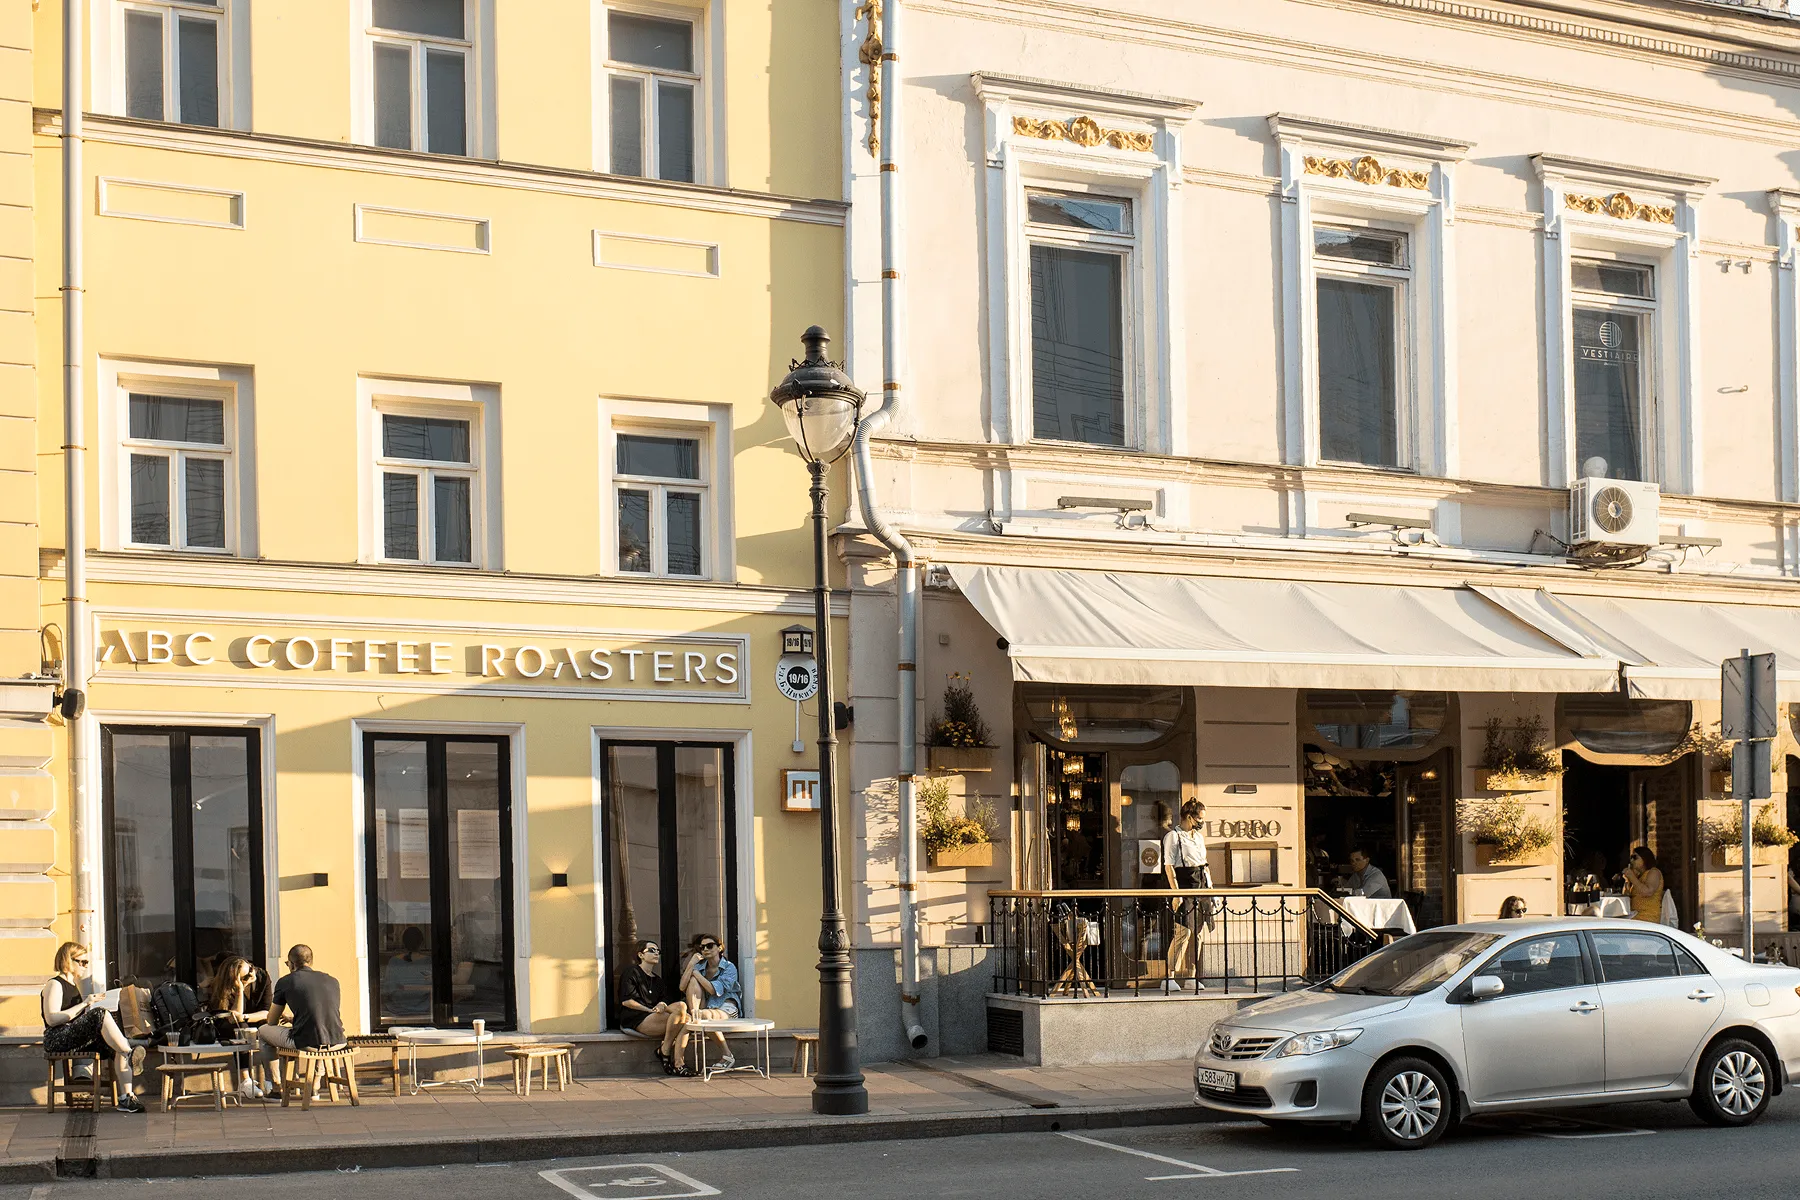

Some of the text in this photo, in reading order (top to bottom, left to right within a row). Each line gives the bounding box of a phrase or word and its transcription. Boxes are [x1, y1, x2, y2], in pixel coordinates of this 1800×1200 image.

[1582, 349, 1638, 361] VESTIAIRE
[101, 628, 738, 685] ABC COFFEE ROASTERS
[789, 674, 809, 684] 19/16
